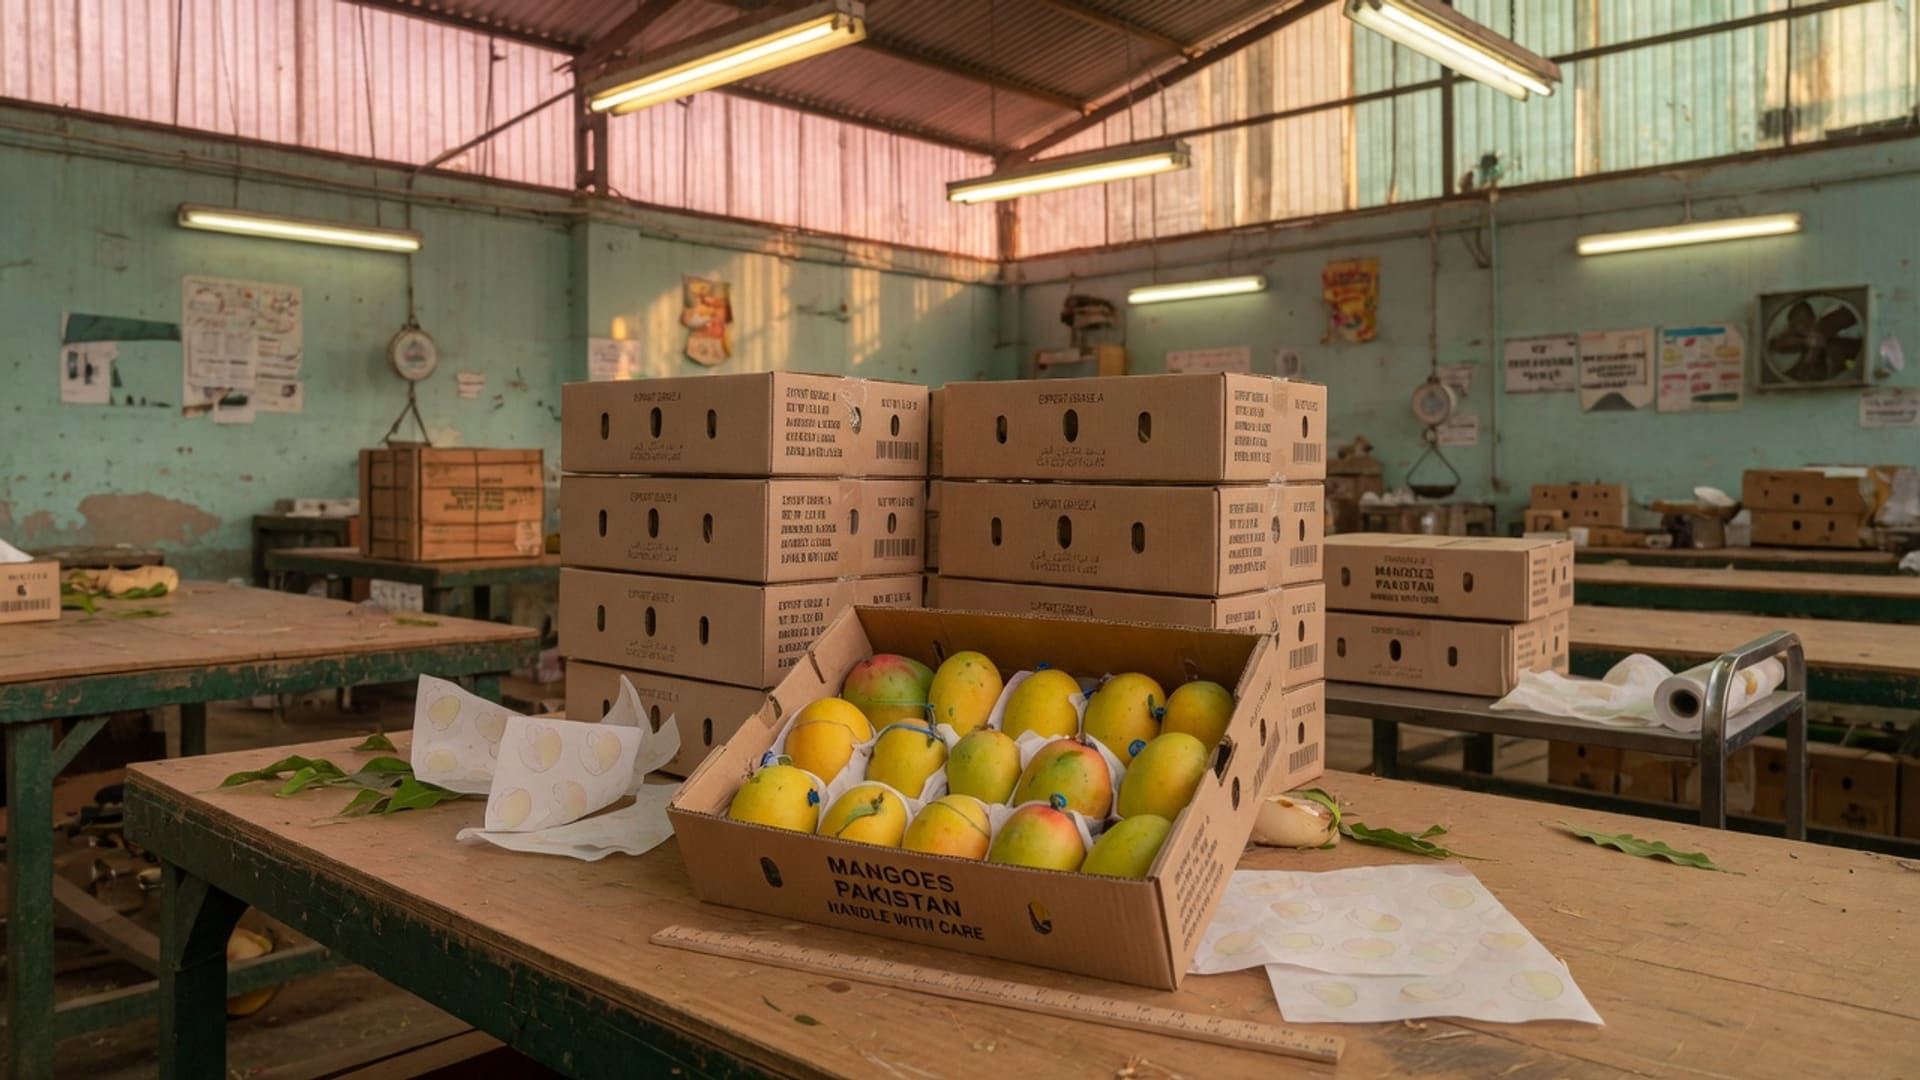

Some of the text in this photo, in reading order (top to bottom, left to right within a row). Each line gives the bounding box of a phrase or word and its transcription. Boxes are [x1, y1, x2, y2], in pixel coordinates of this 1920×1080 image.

[826, 855, 954, 893] MANGOES
[833, 880, 962, 918] PAKISTAN
[827, 901, 985, 941] HANDLE WITH CARE
